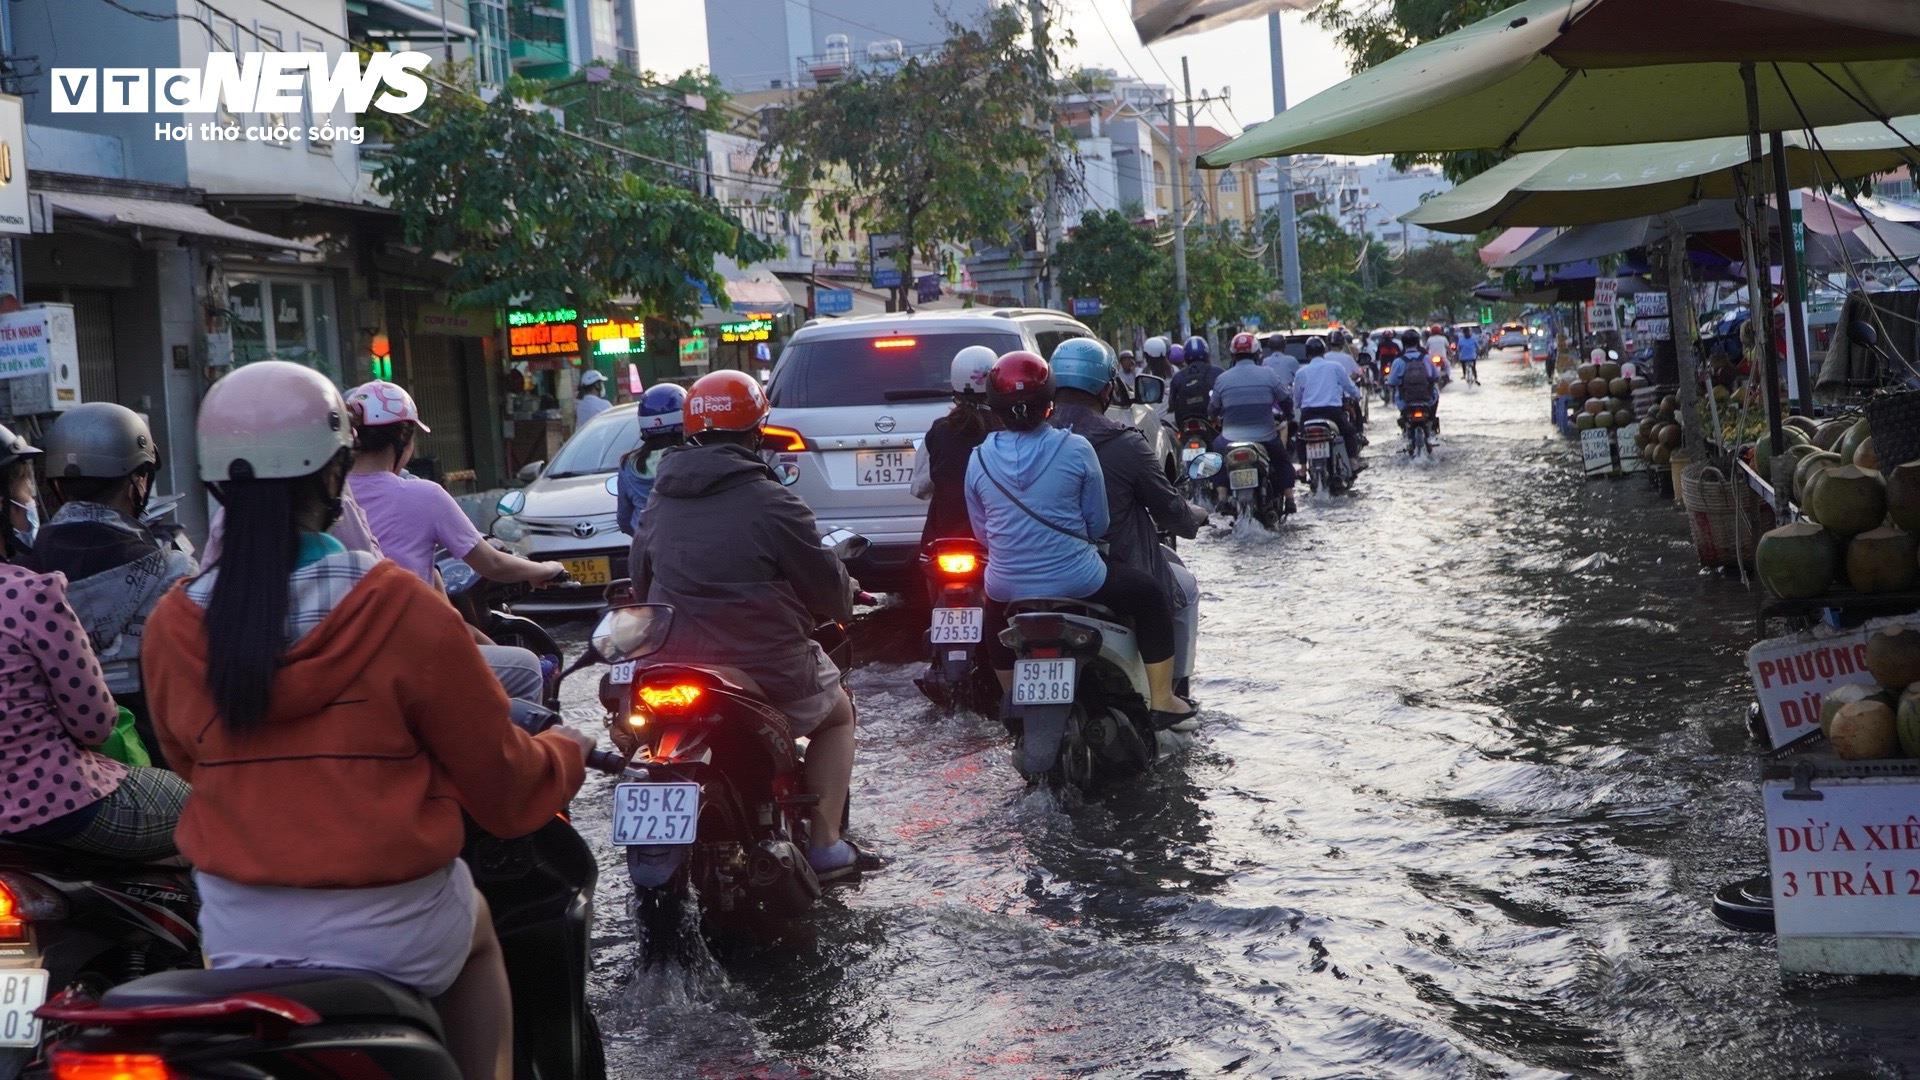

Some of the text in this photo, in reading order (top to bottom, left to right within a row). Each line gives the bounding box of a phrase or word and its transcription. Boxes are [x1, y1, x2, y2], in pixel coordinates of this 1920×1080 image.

[705, 402, 732, 412] Food
[874, 453, 903, 468] 51H
[864, 468, 914, 484] 419.77
[940, 611, 973, 625] 76-B1
[935, 626, 979, 640] 735.53
[1023, 662, 1064, 681] 59-H1
[1017, 682, 1070, 701] 683.86
[627, 788, 686, 813] 59-K2
[617, 815, 692, 841] 472.57
[1776, 817, 1857, 853] DỪA
[1782, 871, 1799, 898] 3
[1806, 861, 1895, 897] TRÁI
[126, 886, 190, 903] BLADE
